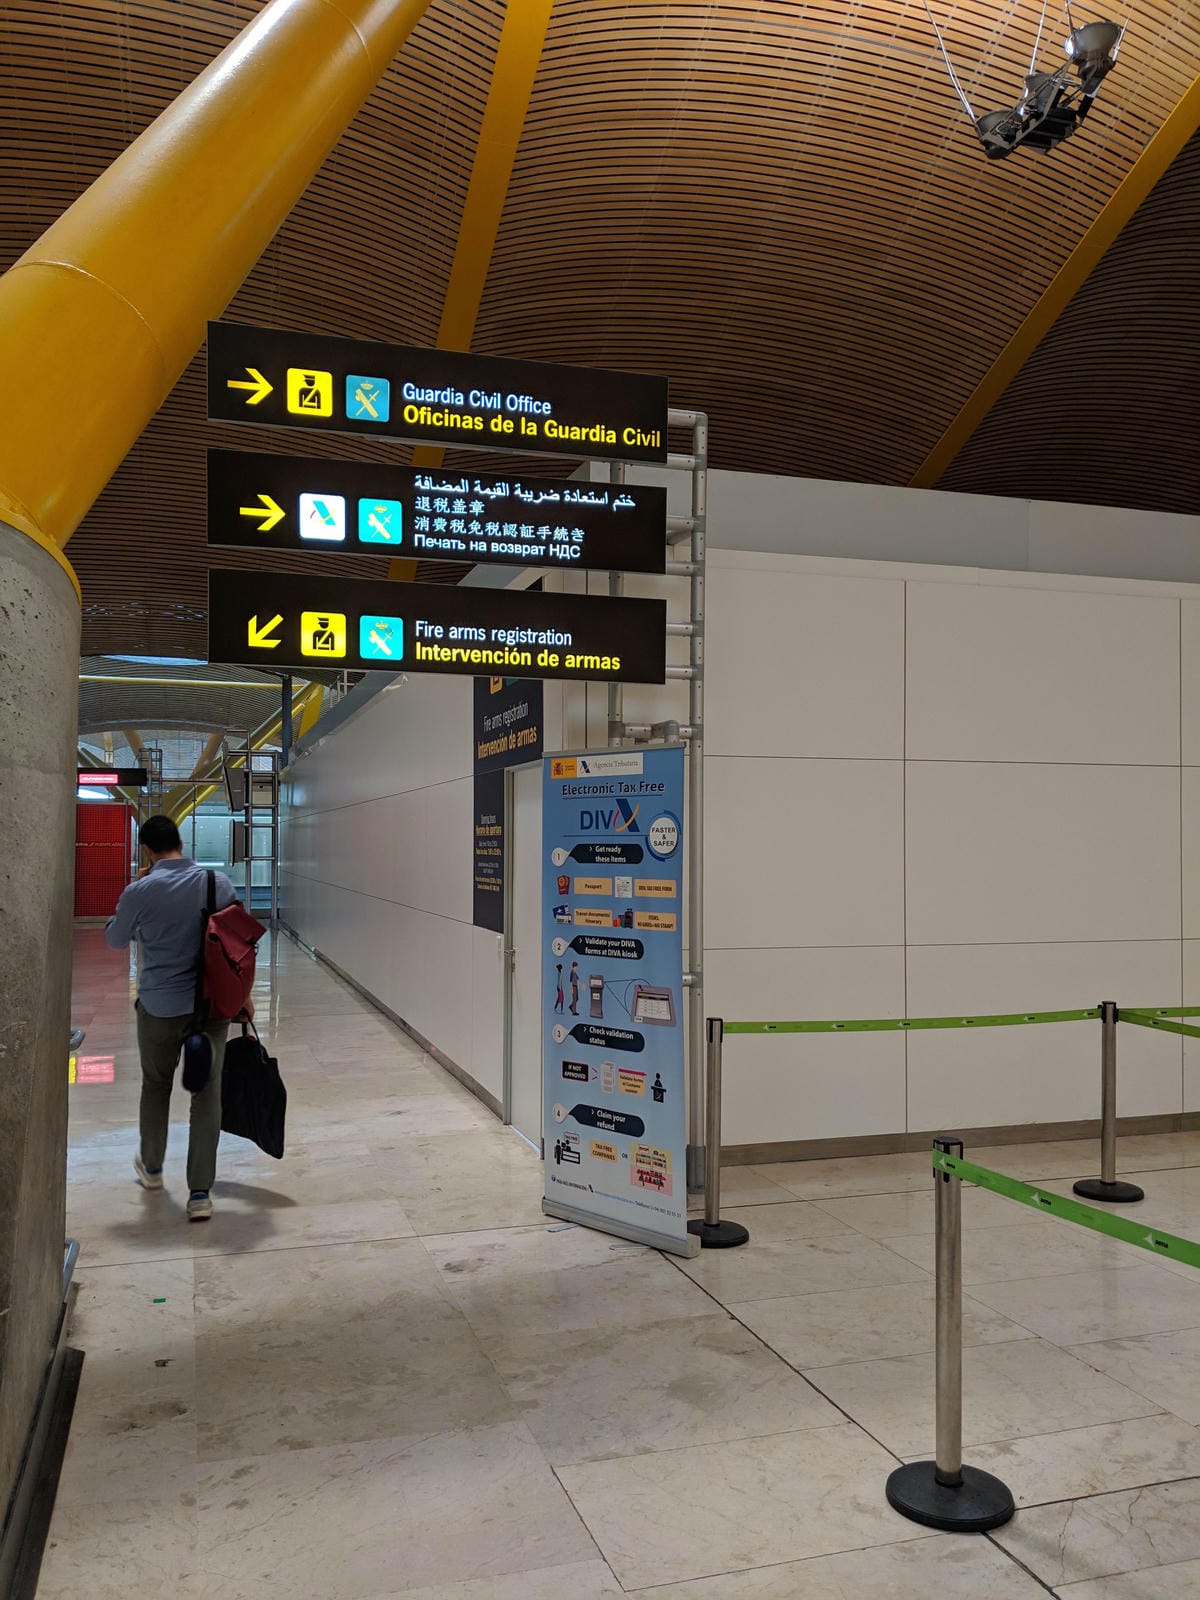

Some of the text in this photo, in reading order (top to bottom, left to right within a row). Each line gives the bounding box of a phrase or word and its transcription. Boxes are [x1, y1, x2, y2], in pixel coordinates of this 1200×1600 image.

[403, 383, 551, 414] Guardia Civil Office
[404, 405, 660, 448] Oficinas de la Guardia Civil
[414, 475, 636, 512] ختم استعادة ضريبة القيمة المضافة
[415, 496, 485, 516] 退税盖章
[414, 516, 585, 542] 消費税免税認証手続き
[414, 534, 581, 559] Печать на возврат НДС
[416, 621, 572, 646] Fire arms registration
[416, 642, 621, 670] Intervención de armas
[503, 700, 528, 727] registration
[509, 729, 516, 750] de
[517, 726, 537, 748] armas
[562, 781, 665, 795] Electronic Tax Free
[595, 845, 621, 855] Get ready
[653, 840, 675, 848] SAFER
[595, 855, 626, 864] these items
[557, 943, 562, 951] 2
[585, 937, 635, 948] Validate your DIVA
[585, 947, 601, 956] forms
[608, 949, 621, 957] DIVA
[622, 951, 638, 959] kiosk
[589, 1026, 634, 1040] Check validation
[589, 1037, 606, 1046] status
[597, 1110, 626, 1123] Claim your
[597, 1120, 615, 1130] refund
